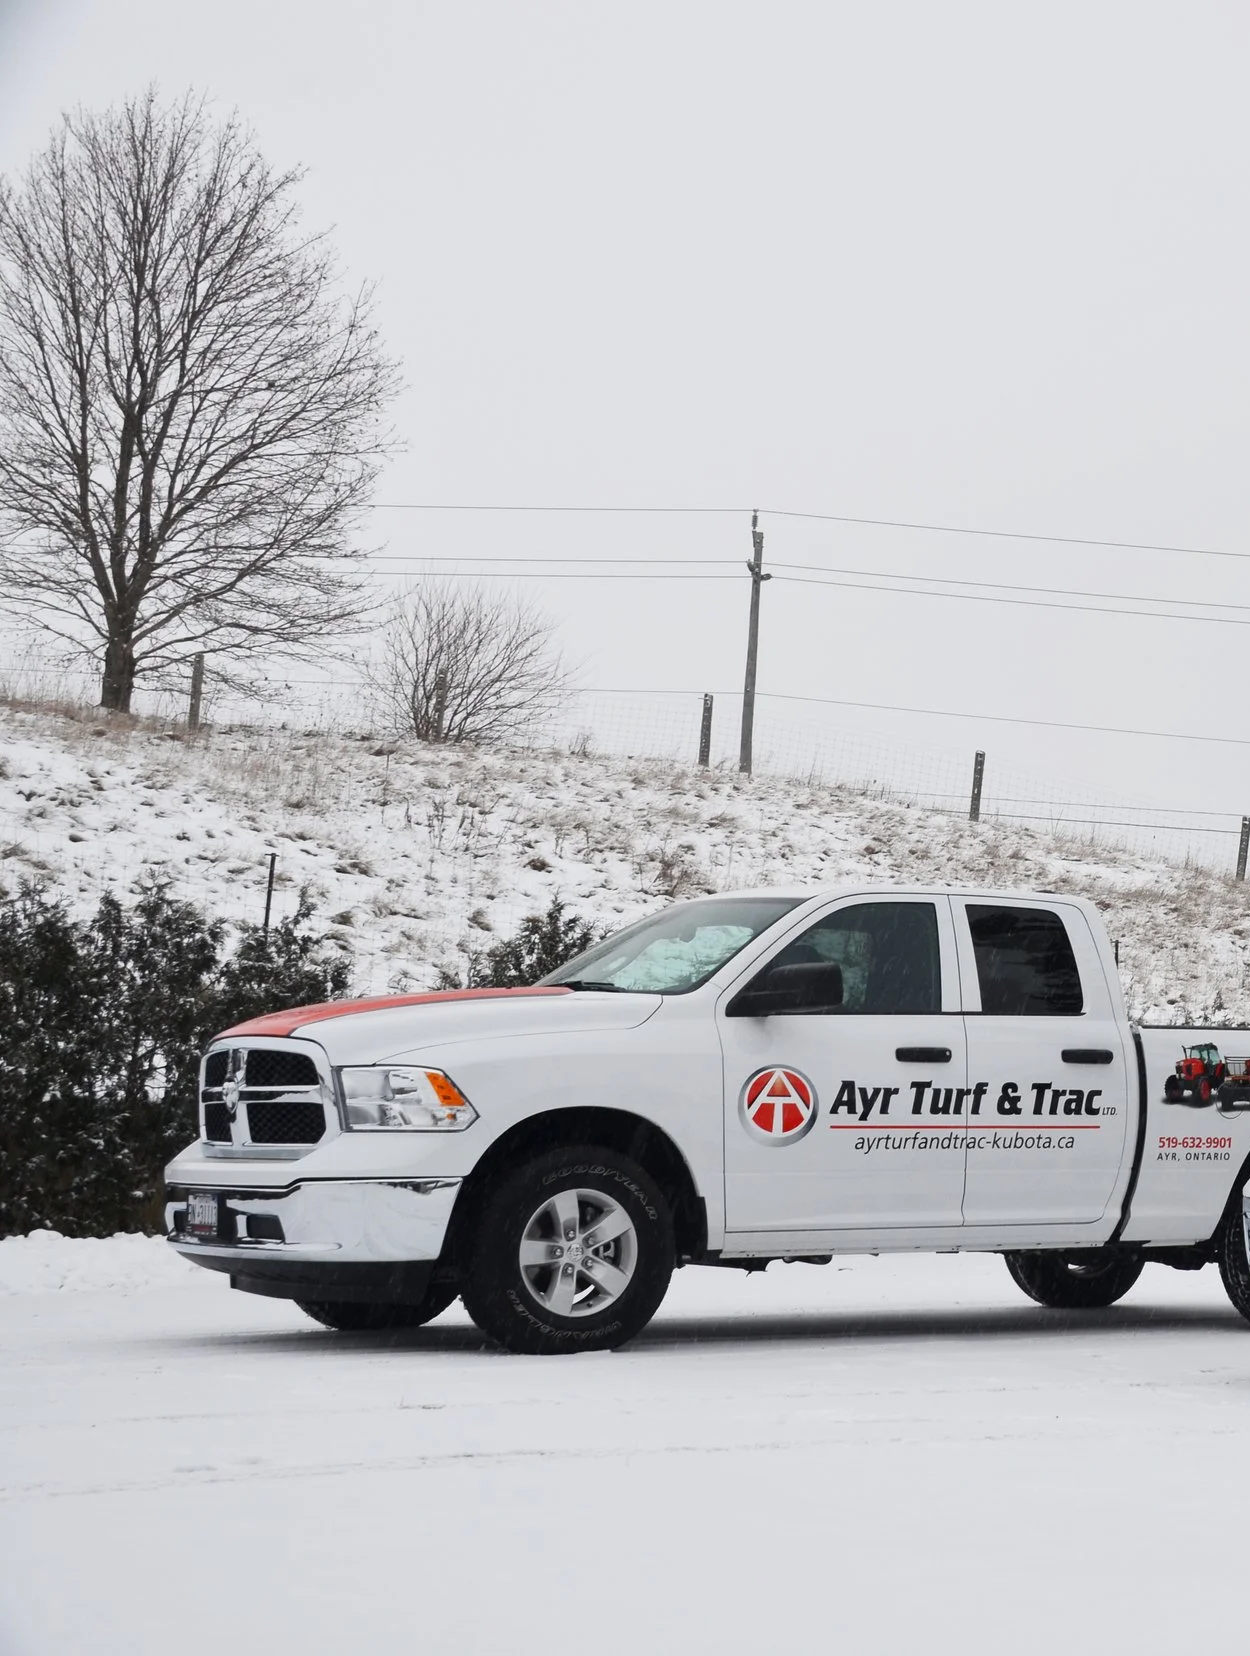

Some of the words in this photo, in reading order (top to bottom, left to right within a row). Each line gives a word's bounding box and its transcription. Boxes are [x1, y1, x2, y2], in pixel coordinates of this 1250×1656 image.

[829, 1080, 900, 1121] Ayr
[910, 1080, 990, 1116] Turf
[996, 1081, 1023, 1117] &
[1030, 1081, 1103, 1117] Trac
[1102, 1106, 1119, 1117] LTD.
[854, 1131, 1076, 1155] ayrturfandtrac-kubota.ca
[1158, 1136, 1233, 1149] 519-632-9901
[1156, 1152, 1181, 1162] AYR,
[1185, 1151, 1231, 1161] ONTARIO
